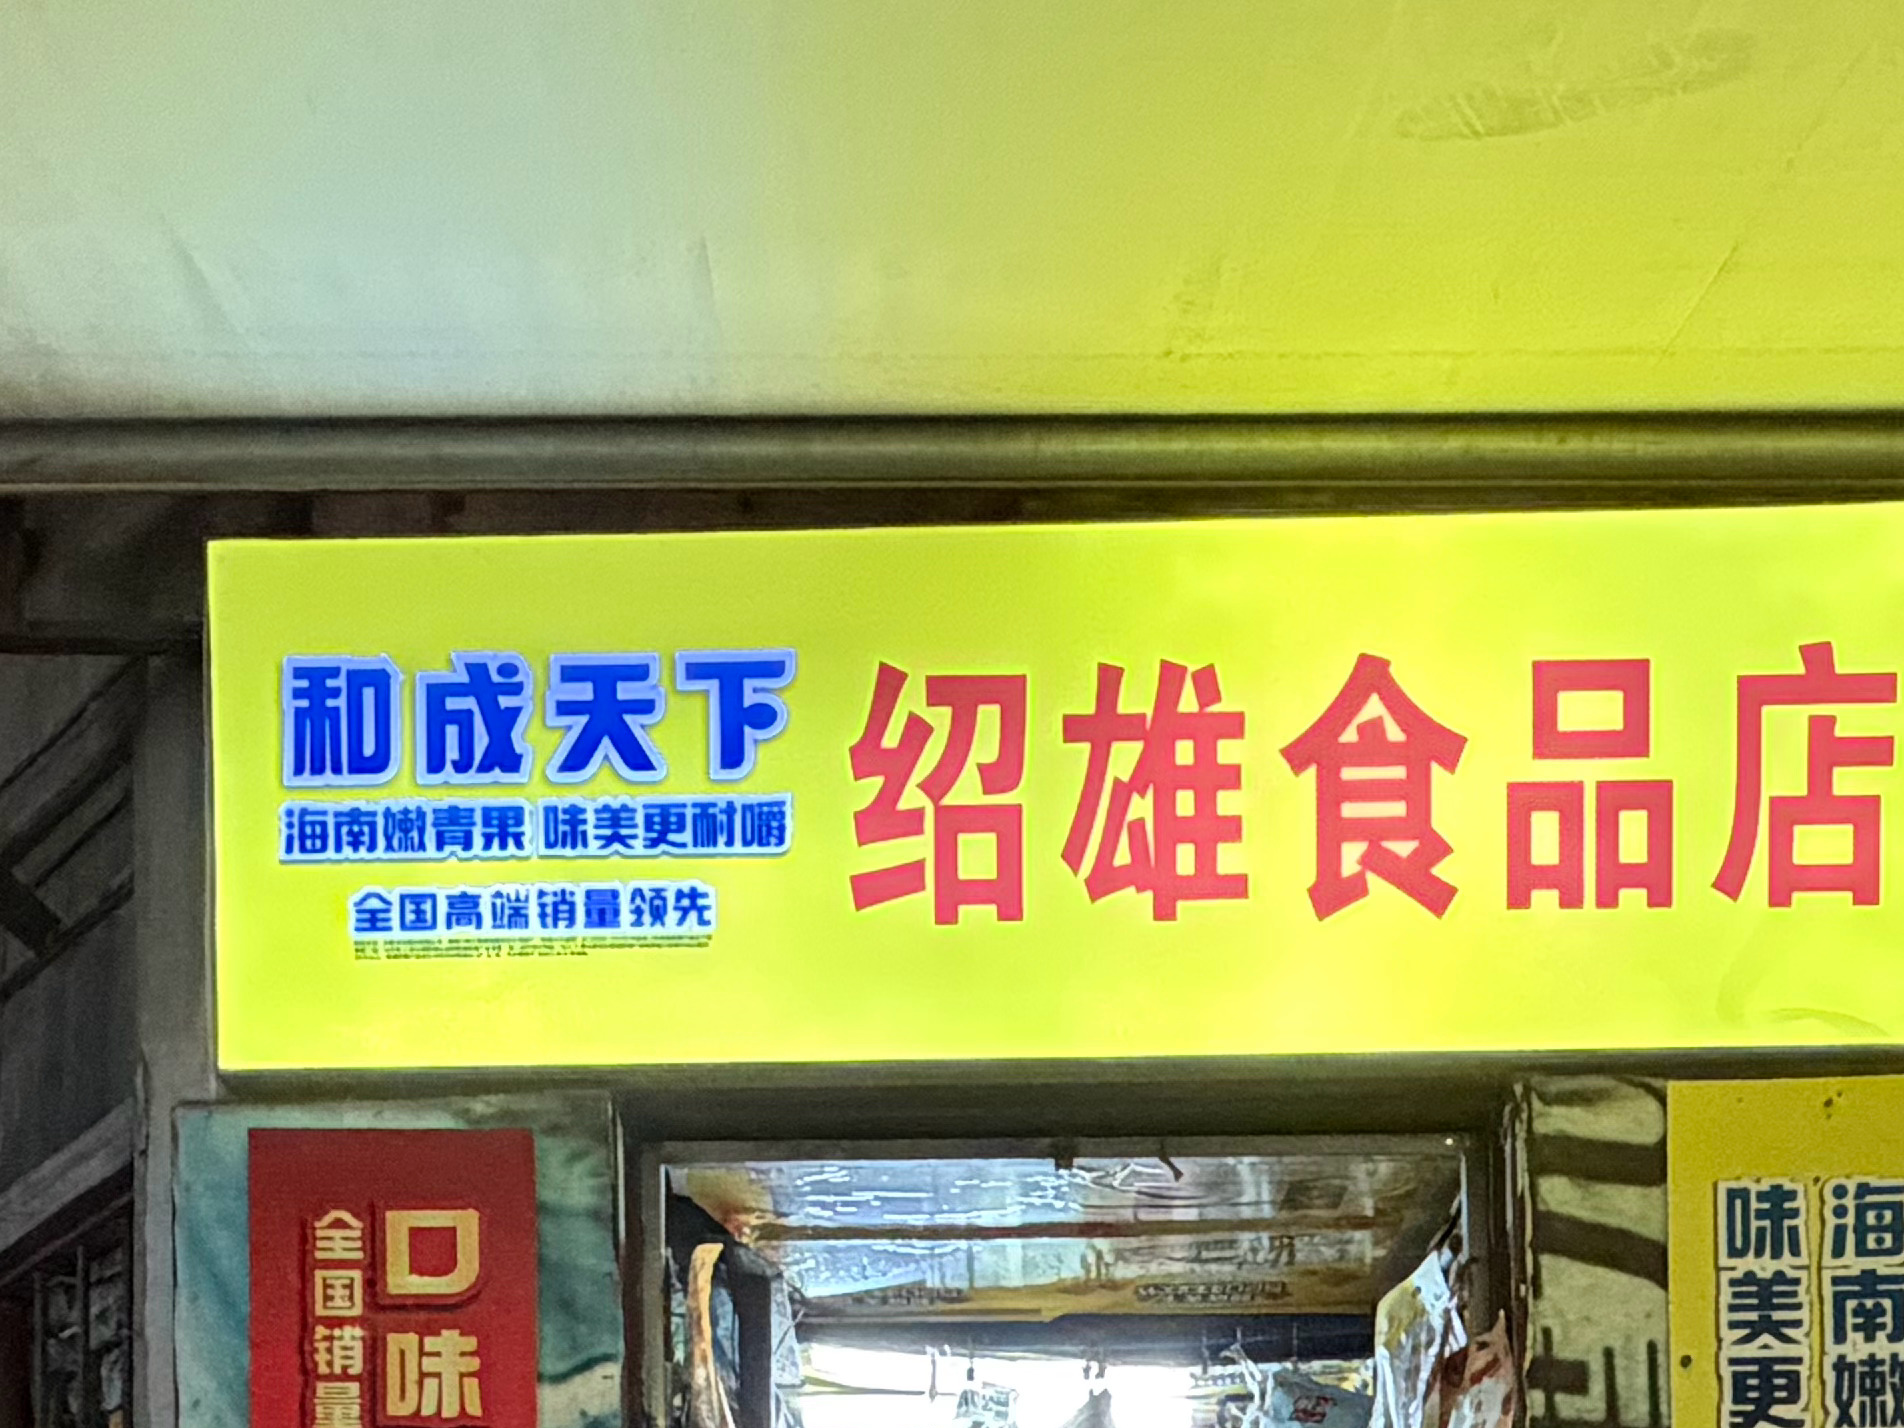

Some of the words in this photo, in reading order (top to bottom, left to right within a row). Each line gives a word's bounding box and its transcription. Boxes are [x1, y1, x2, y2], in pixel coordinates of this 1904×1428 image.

[289, 656, 792, 780] 和成天下
[284, 803, 527, 856] 海南嫩青果
[543, 800, 788, 851] 味美更耐嚼
[848, 640, 1897, 926] 绍雄食品店
[353, 886, 713, 933] 全国高端销量领先
